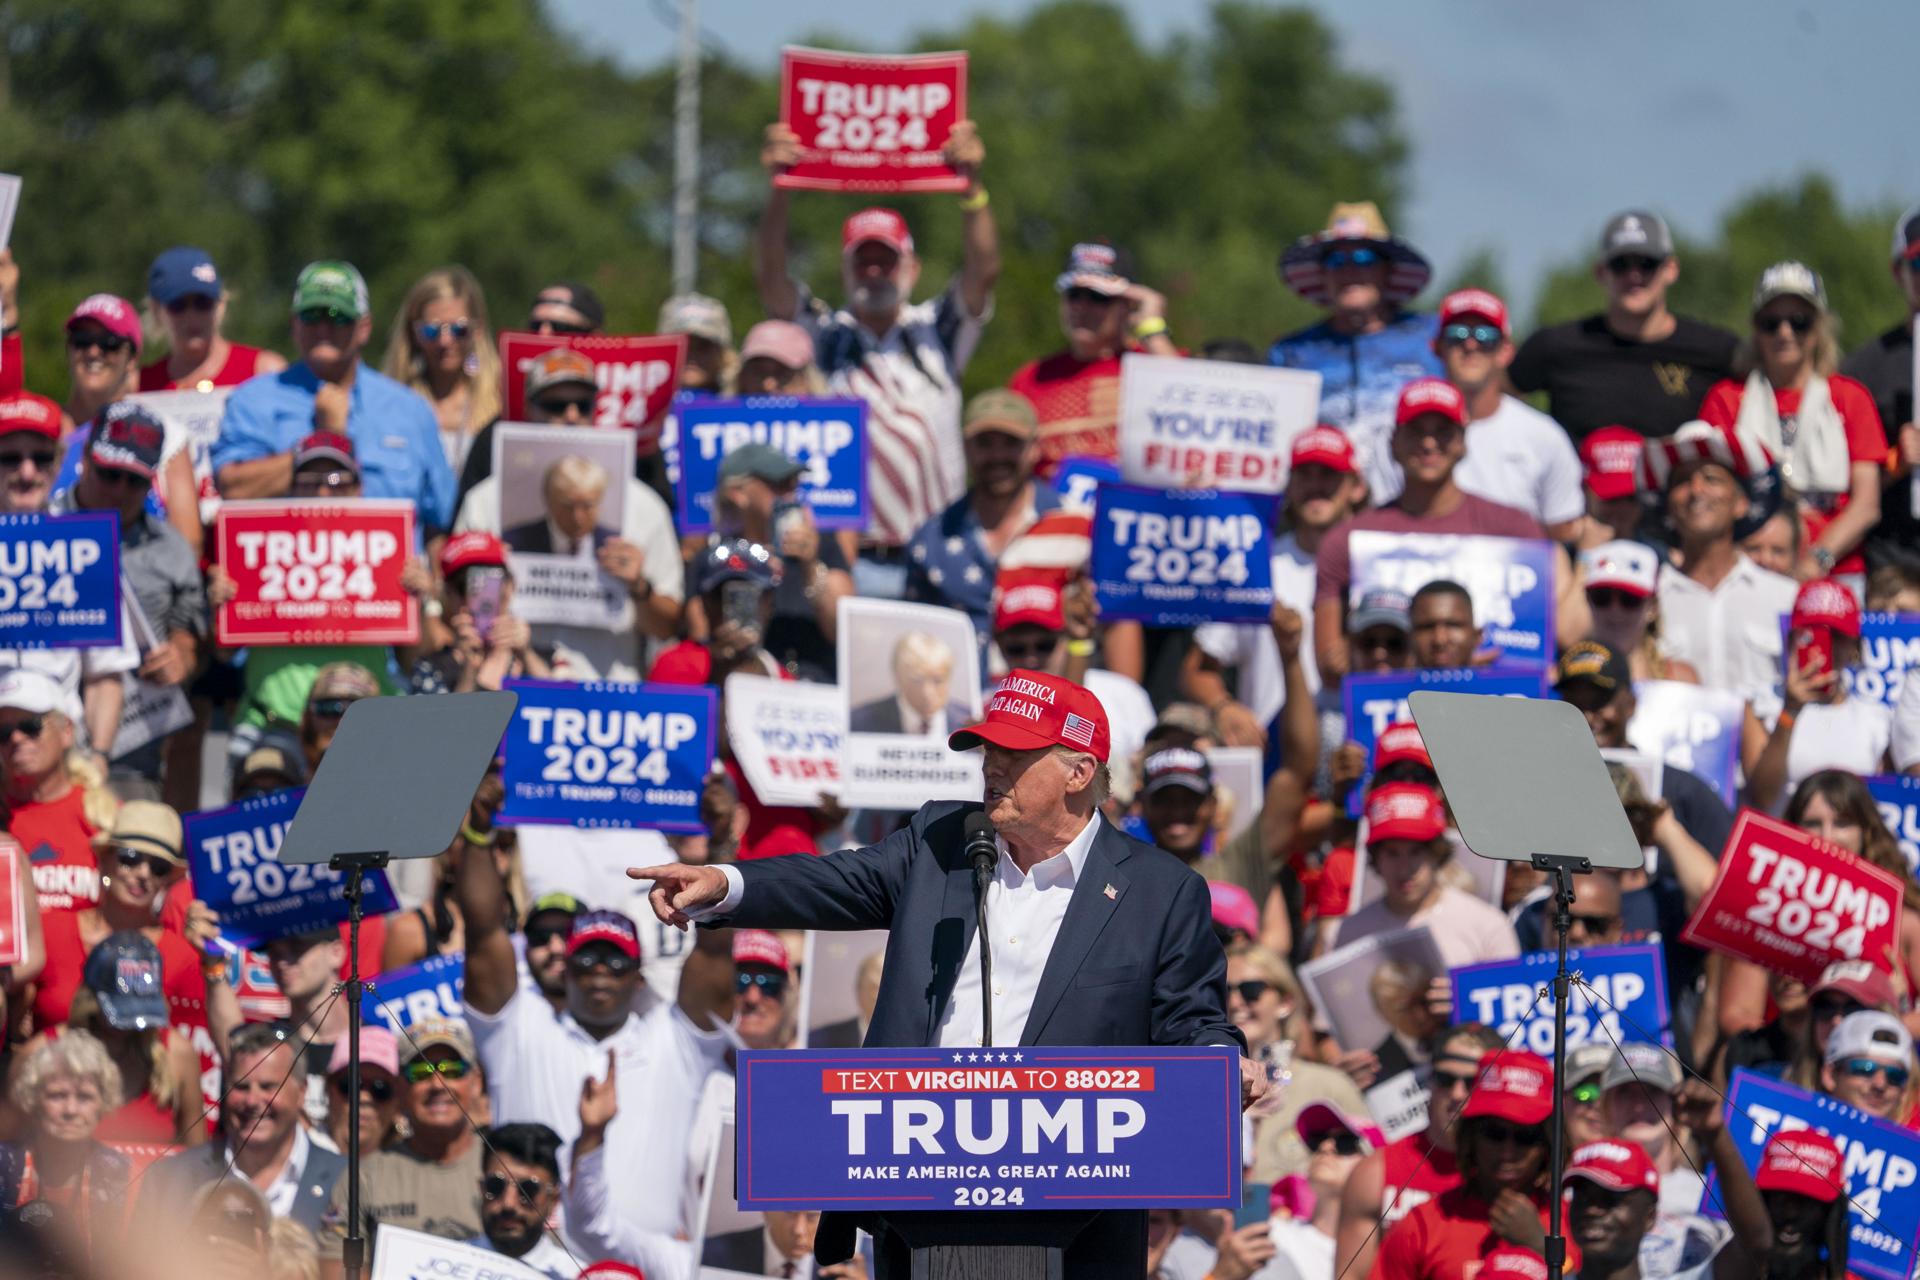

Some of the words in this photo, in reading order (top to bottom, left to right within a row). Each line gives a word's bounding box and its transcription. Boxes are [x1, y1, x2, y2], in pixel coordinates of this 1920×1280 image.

[797, 78, 951, 118] TRUMP
[814, 113, 929, 150] 2024
[596, 396, 649, 428] 24
[1148, 409, 1276, 448] YOU'RE
[1145, 442, 1281, 484] FIRED!
[236, 529, 397, 569] TRUMP
[1107, 507, 1262, 551] TRUMP
[0, 538, 101, 578] UMP
[1125, 546, 1249, 586] 2024
[0, 573, 79, 611] 024
[258, 564, 376, 601] 2024
[1002, 697, 1043, 722] AGAIN
[1005, 676, 1056, 706] AMERICA
[520, 706, 697, 751] TRUMP
[541, 744, 670, 786] 2024
[767, 757, 841, 782] FIRE
[559, 784, 617, 802] TRUMP
[201, 820, 292, 874] TRU
[226, 862, 341, 905] 2024
[1747, 842, 1891, 932] TRUMP
[1745, 887, 1866, 959] 2024
[373, 983, 463, 1036] TRU
[1469, 971, 1645, 1025] TRUMP
[1497, 1011, 1625, 1057] 2024
[837, 1071, 898, 1090] TEXT
[906, 1071, 1017, 1089] VIRGINIA
[1024, 1070, 1057, 1089] TO
[1065, 1070, 1140, 1089] 88022
[831, 1099, 1146, 1155] TRUMP
[1746, 1102, 1918, 1192] TMP
[848, 1167, 900, 1179] MAKE
[906, 1166, 991, 1178] AMERICA
[997, 1166, 1059, 1178] GREAT
[1065, 1165, 1131, 1178] AGAIN!
[954, 1187, 1025, 1206] 2024
[415, 1258, 472, 1279] JOE
